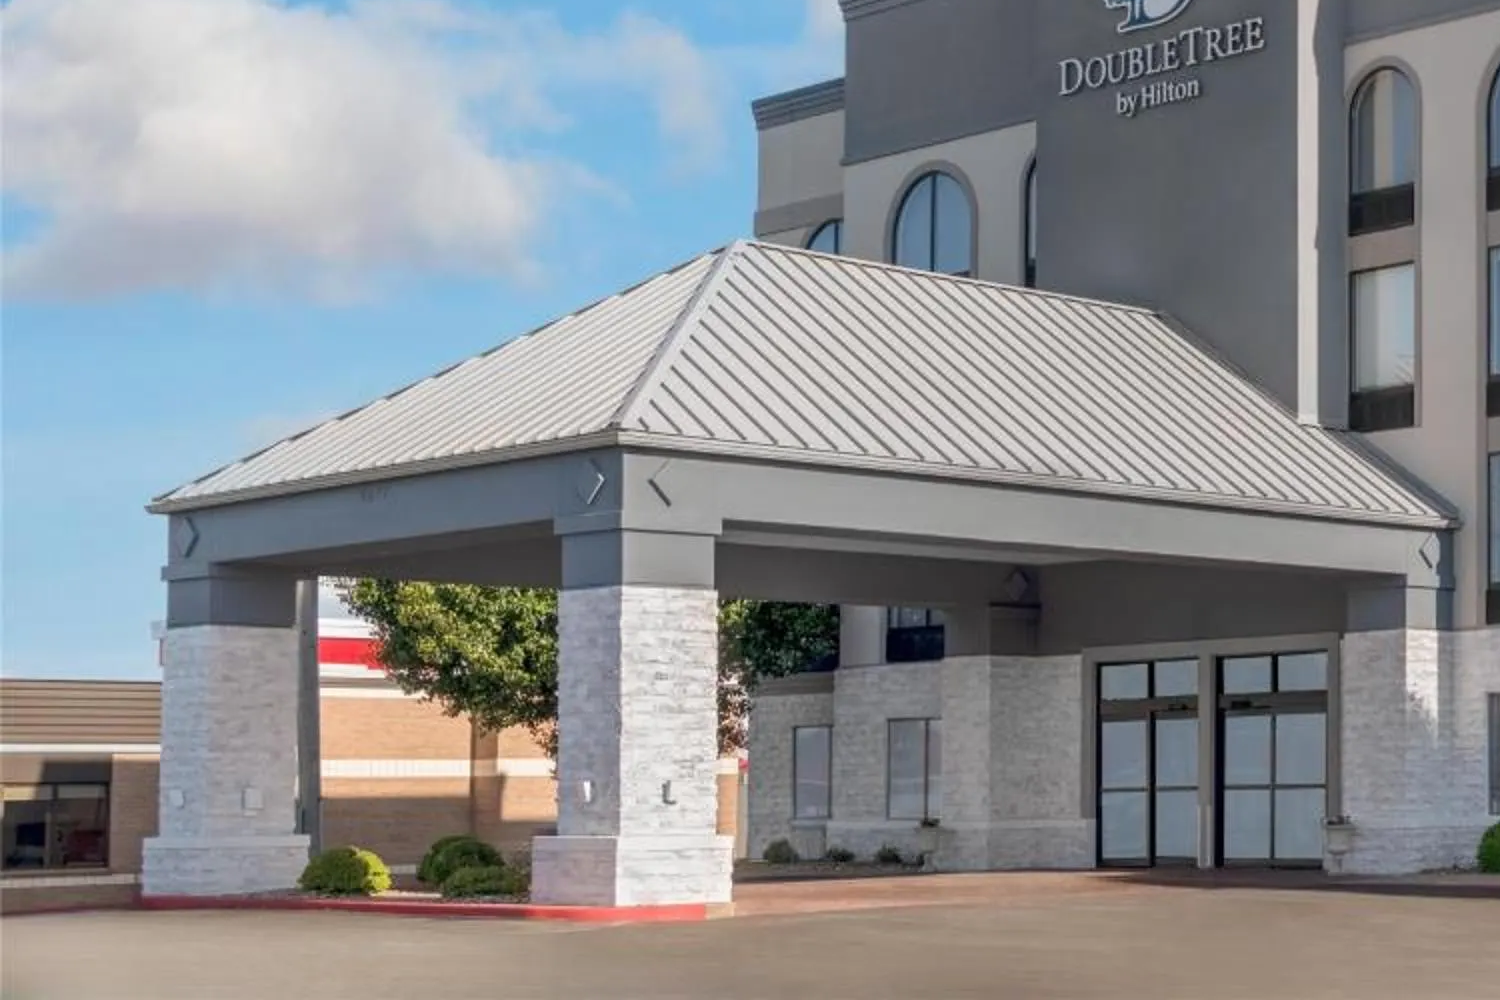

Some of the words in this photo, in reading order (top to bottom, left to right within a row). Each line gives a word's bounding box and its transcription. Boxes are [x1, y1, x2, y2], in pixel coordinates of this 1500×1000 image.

[1058, 17, 1265, 96] DOUBLETREE
[1116, 92, 1137, 117] by
[1141, 79, 1200, 107] Hilton
